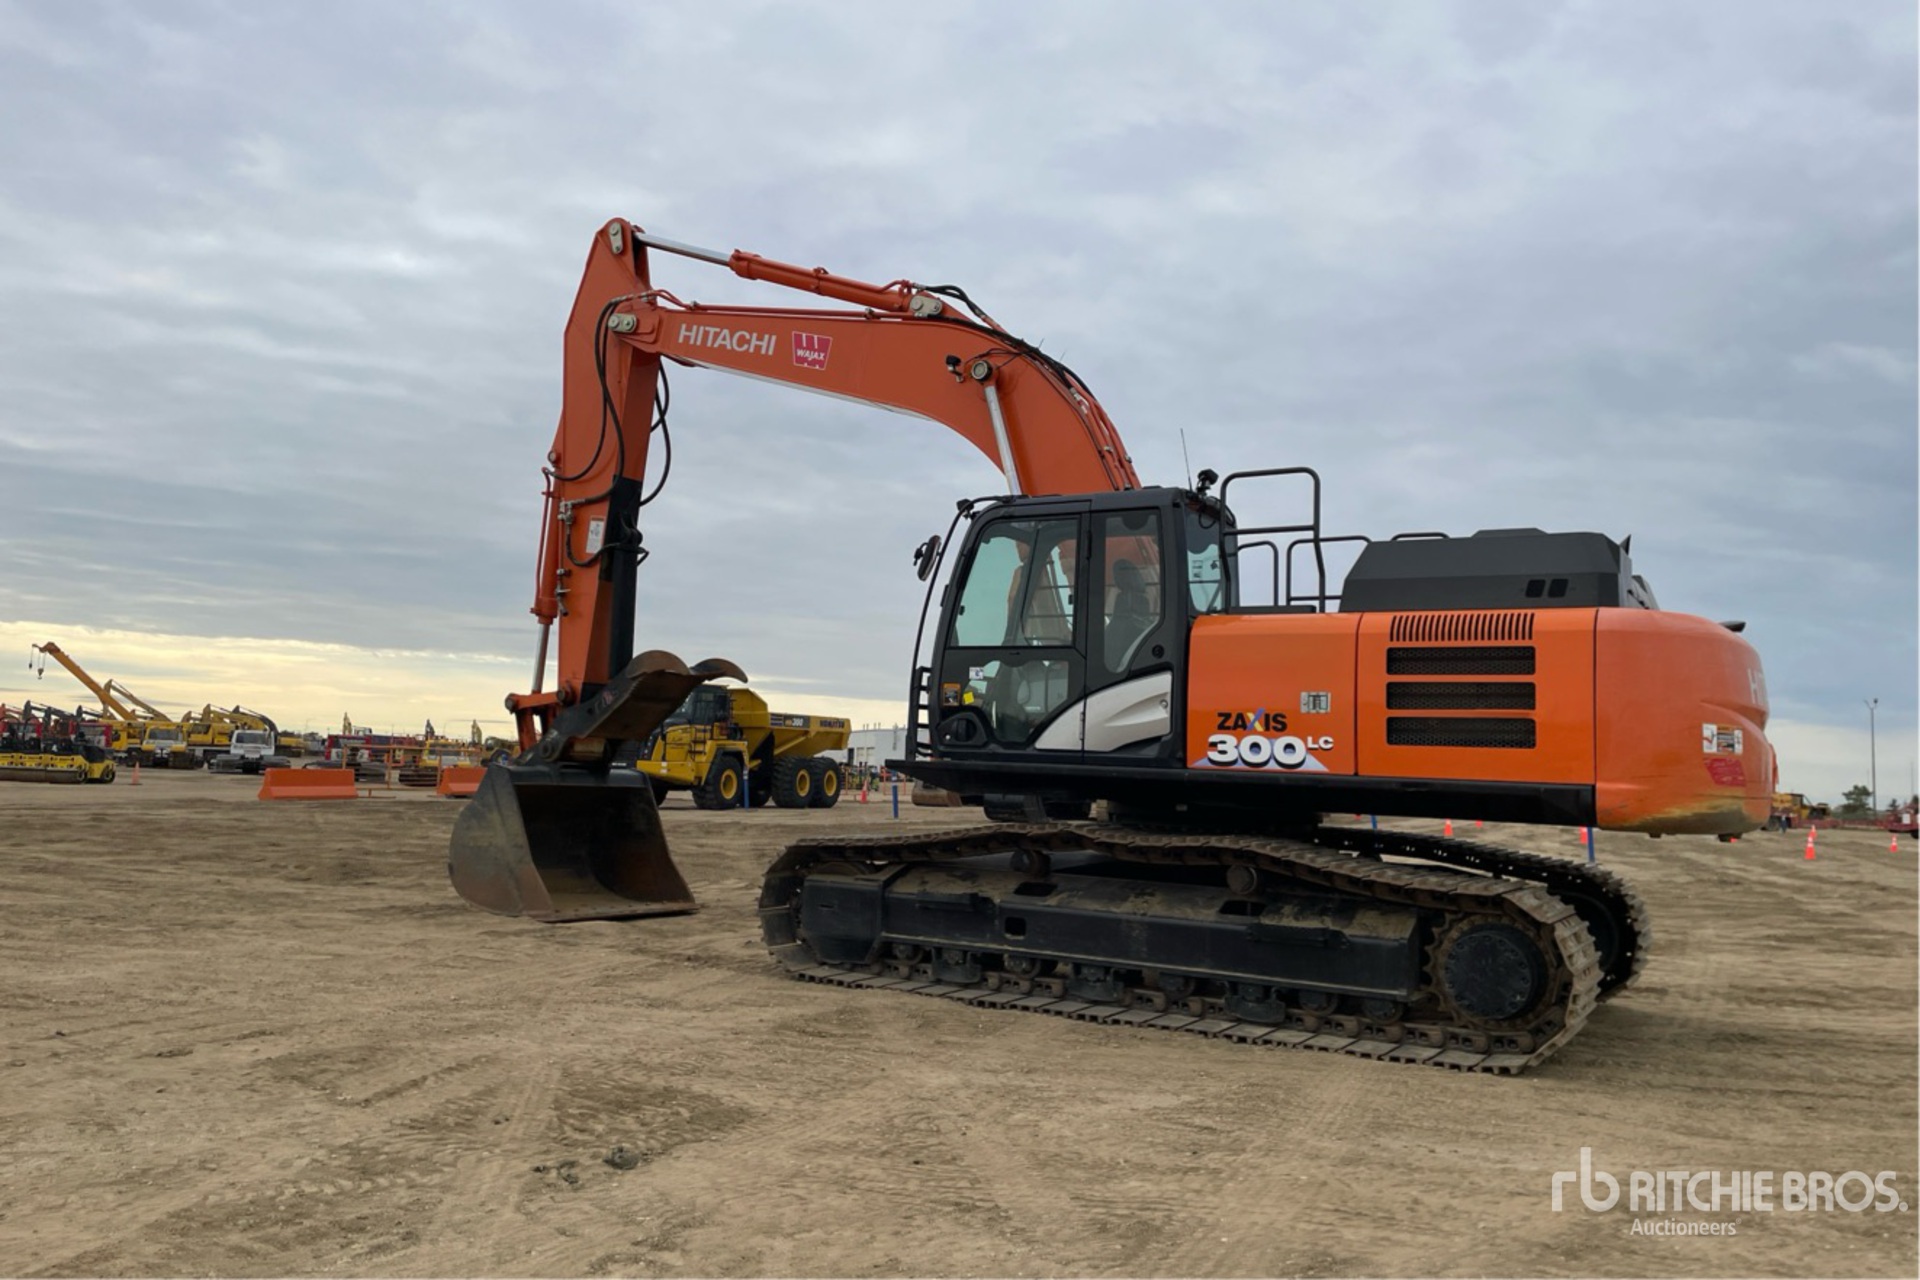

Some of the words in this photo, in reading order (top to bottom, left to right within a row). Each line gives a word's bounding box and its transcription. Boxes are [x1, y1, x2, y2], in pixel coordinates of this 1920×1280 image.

[678, 323, 777, 356] HITACHI
[796, 348, 825, 361] WAJAX
[1217, 708, 1287, 732] ZAXIS
[1207, 734, 1307, 768] 300
[1307, 736, 1334, 751] LC
